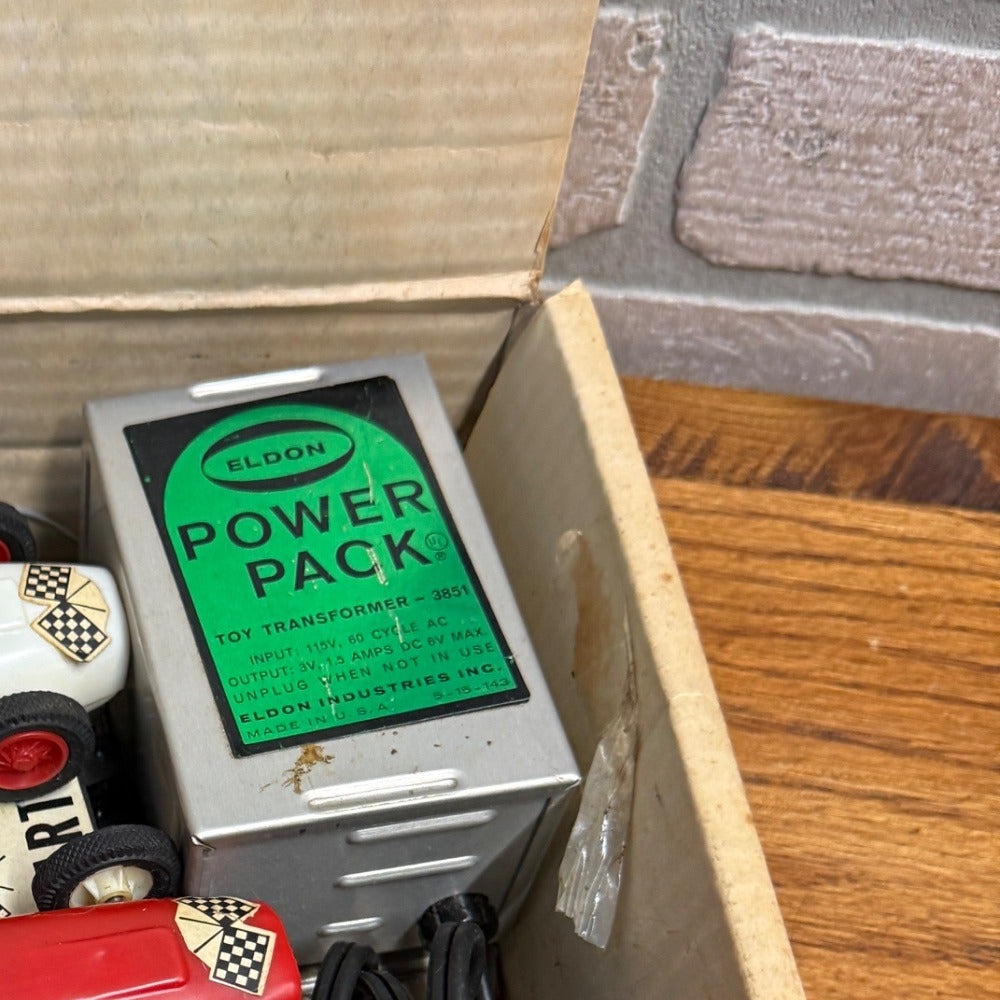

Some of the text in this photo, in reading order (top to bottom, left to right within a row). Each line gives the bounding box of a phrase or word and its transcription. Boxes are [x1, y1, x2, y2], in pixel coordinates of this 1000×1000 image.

[225, 441, 327, 473] ELDON
[177, 479, 432, 562] POWER
[245, 528, 433, 599] PACK
[215, 628, 254, 645] TOY
[261, 596, 409, 635] TRANSFORMER
[431, 584, 469, 601] 3851
[347, 632, 365, 645] 60
[371, 622, 419, 642] CYCLE
[426, 615, 448, 630] AC
[227, 664, 294, 688] OUTPUT:
[350, 644, 394, 661] AMPS
[400, 638, 422, 651] DC
[426, 634, 445, 646] 6V
[233, 642, 495, 703] UNPLUG WHEN NOT IN USE
[239, 661, 503, 723] ELDON INDUSTRIES INC.
[246, 720, 299, 739] MADE
[308, 715, 325, 726] IN
